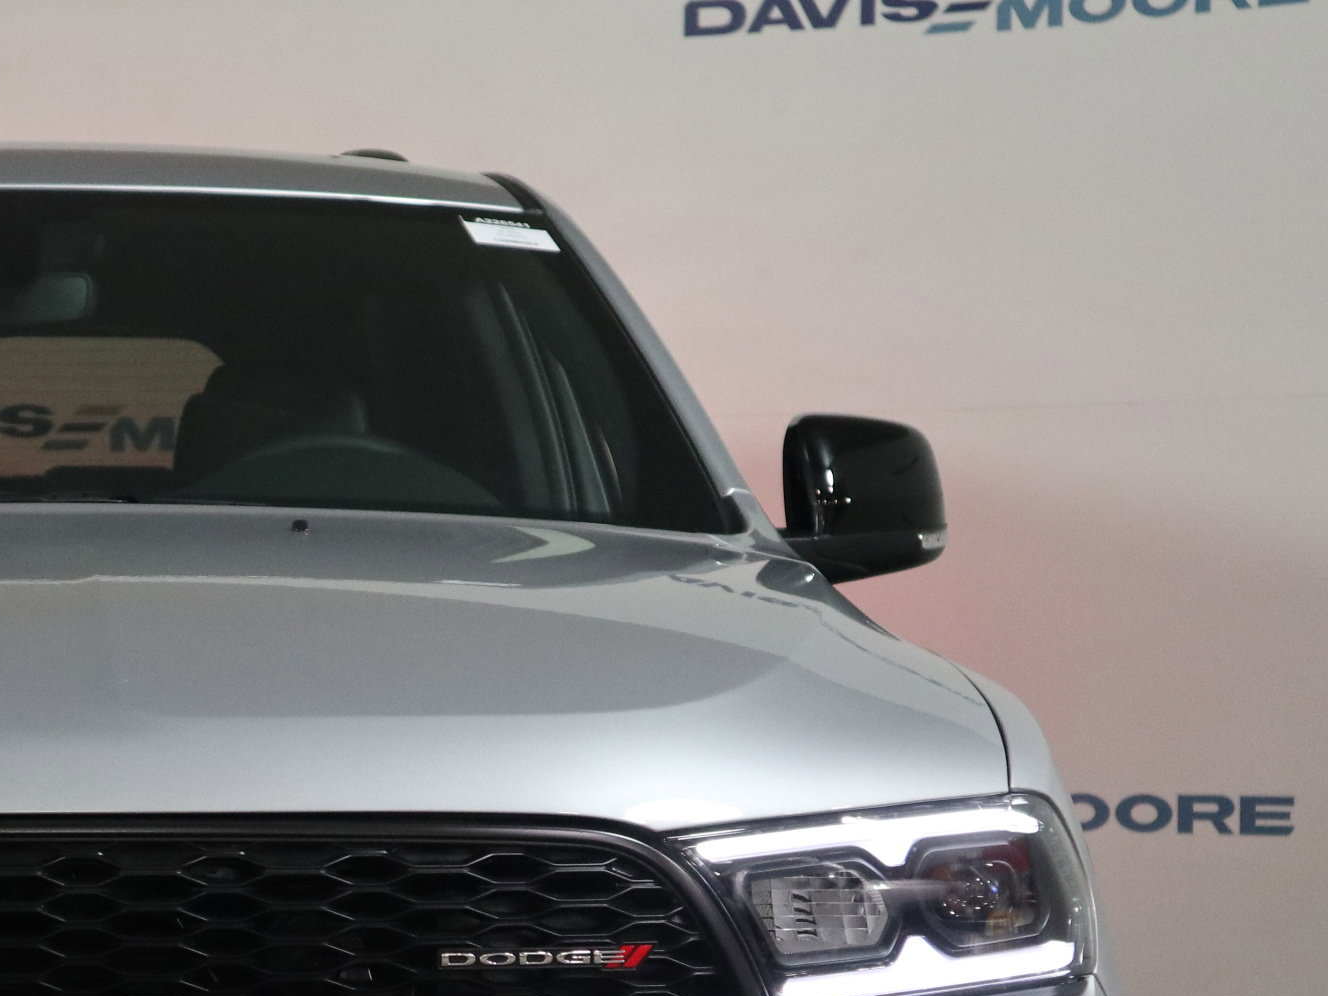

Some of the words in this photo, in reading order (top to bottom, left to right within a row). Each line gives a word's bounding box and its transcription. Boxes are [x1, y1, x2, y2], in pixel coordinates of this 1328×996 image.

[684, 0, 939, 37] DAVIS
[1071, 793, 1295, 835] OORE
[441, 950, 625, 966] DODGE
